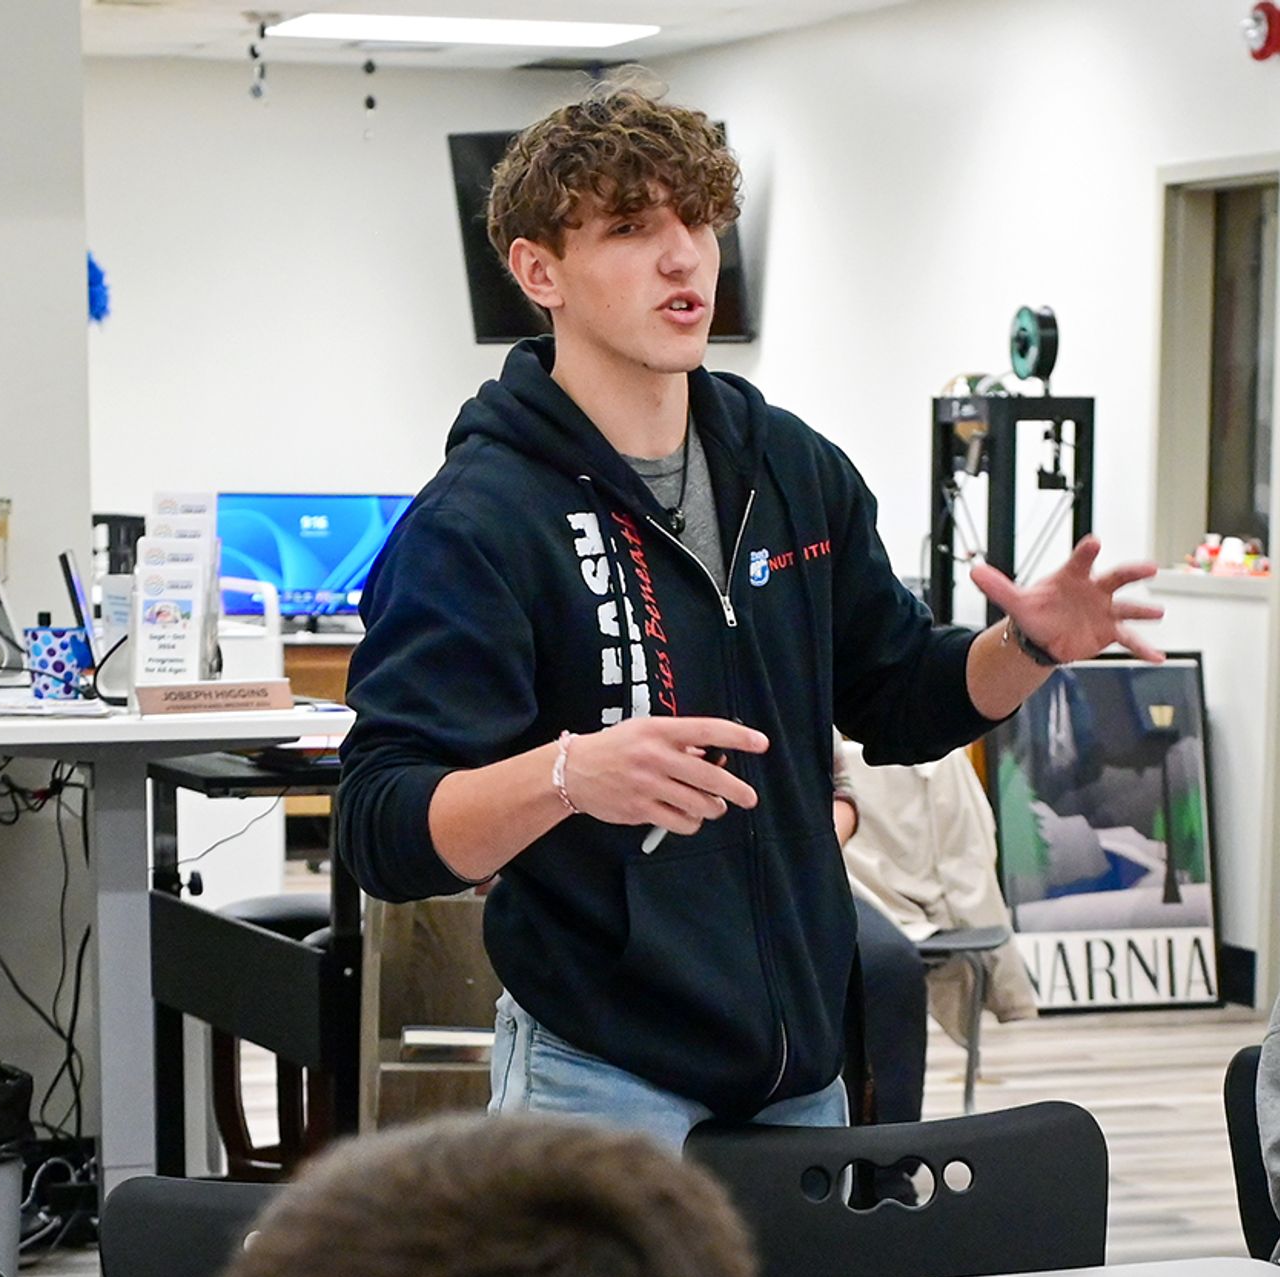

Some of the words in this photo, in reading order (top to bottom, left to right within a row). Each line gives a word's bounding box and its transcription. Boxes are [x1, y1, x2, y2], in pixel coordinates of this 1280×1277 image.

[163, 689, 213, 701] JOSEPH
[214, 687, 269, 699] HIGGINS
[656, 650, 678, 717] Lies
[1022, 937, 1218, 1002] NARNIA
